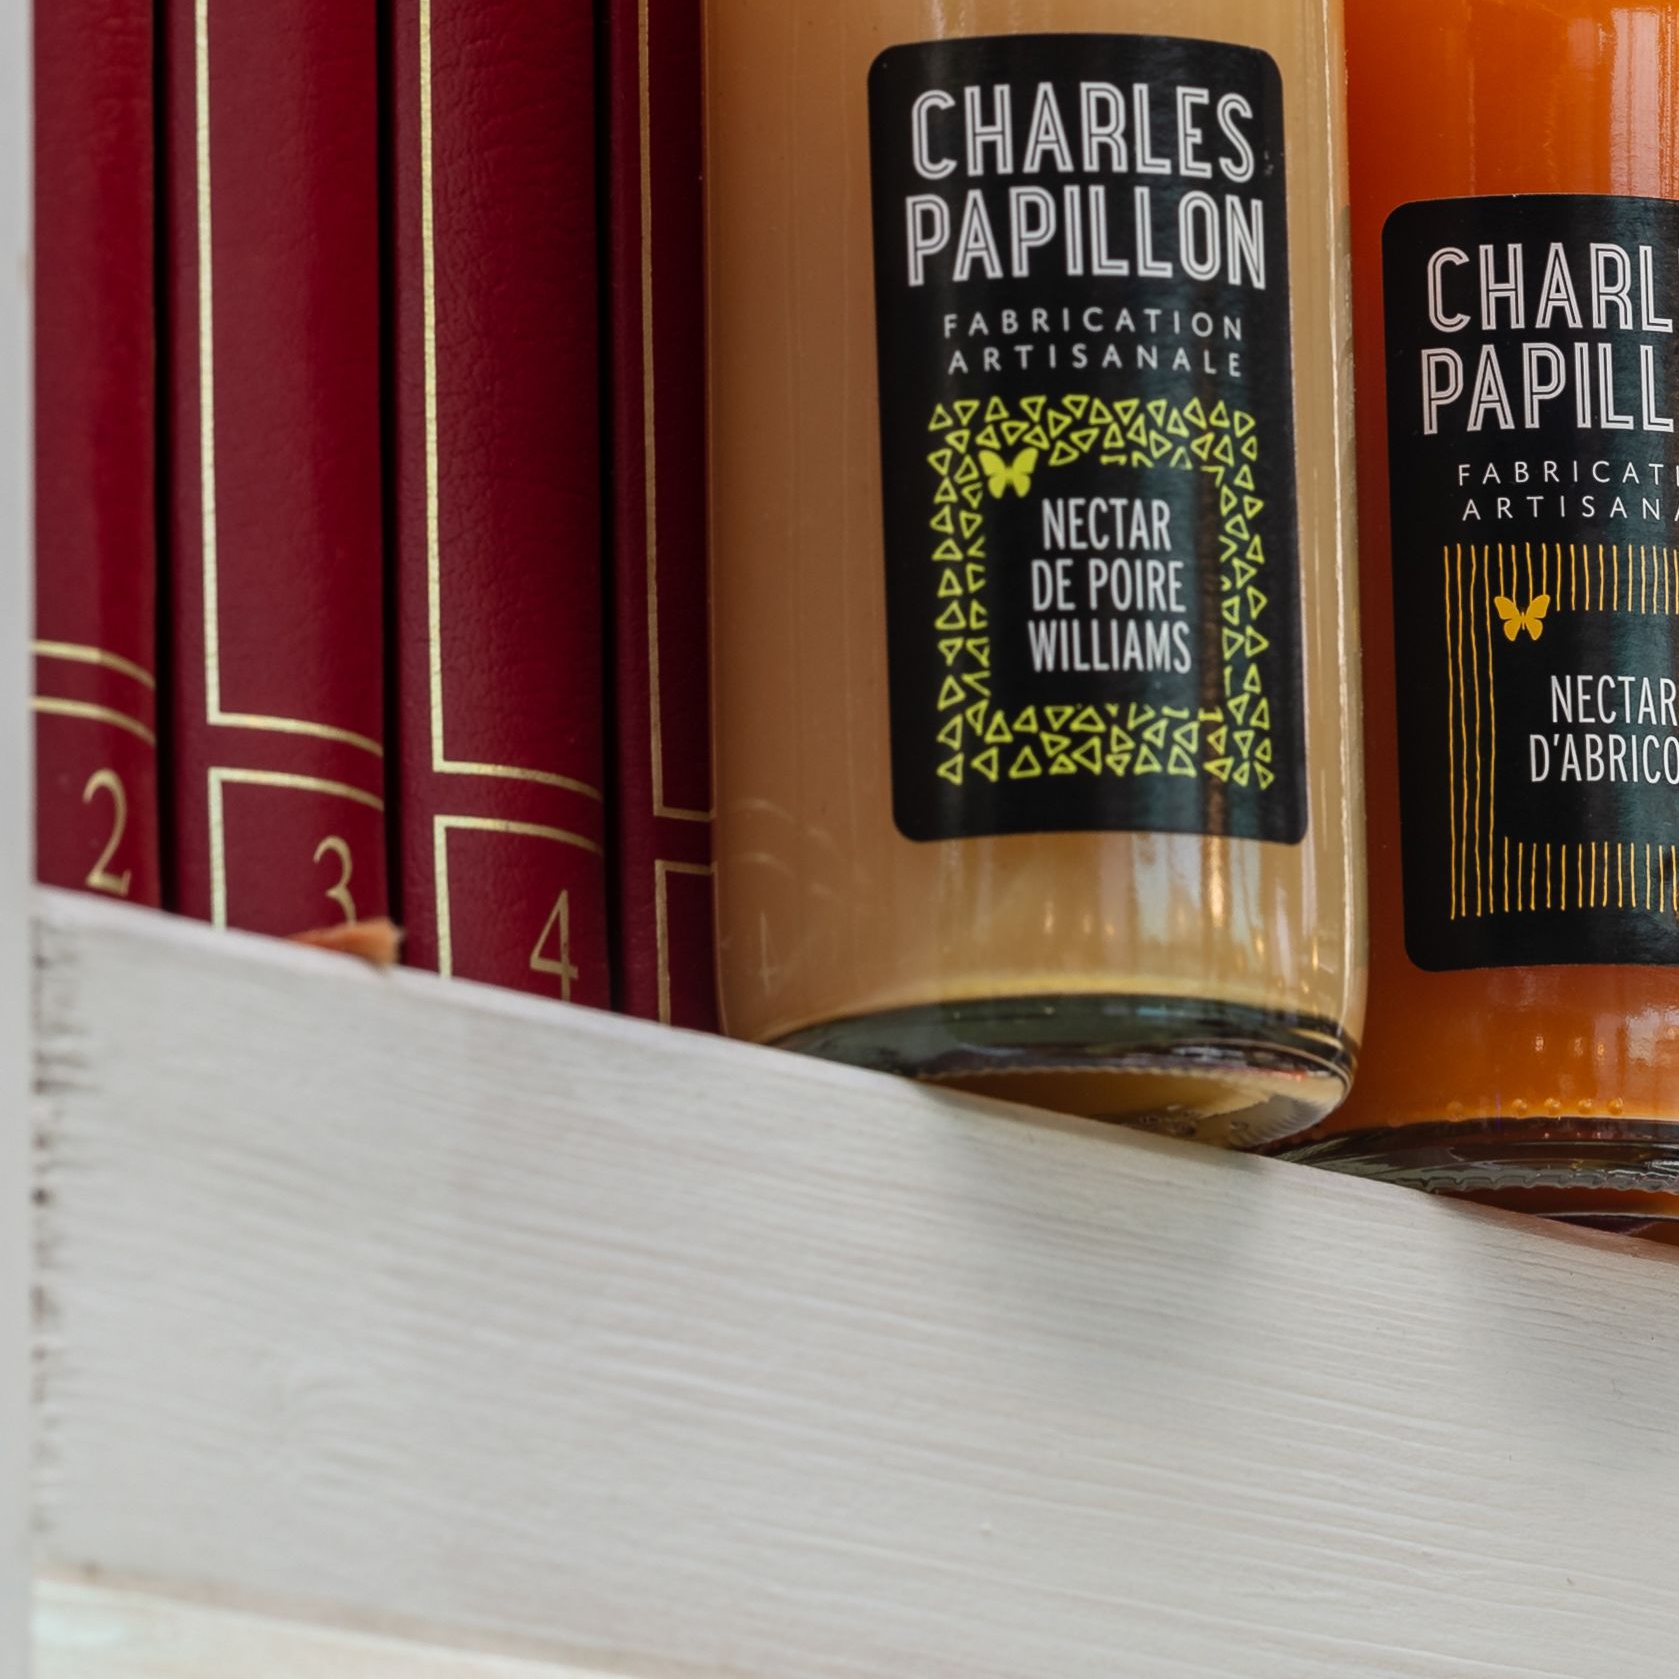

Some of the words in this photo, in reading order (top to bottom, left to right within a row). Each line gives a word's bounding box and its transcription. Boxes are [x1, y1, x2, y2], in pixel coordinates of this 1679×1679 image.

[911, 82, 1255, 183] CHARLES
[906, 185, 1266, 290] PAPILLON
[943, 307, 1242, 341] FABRICATION
[948, 344, 1242, 377] ARTISANALE
[1041, 497, 1172, 551] NECTAR
[1031, 559, 1076, 612] DE
[1088, 559, 1187, 612] POIRE
[1028, 619, 1192, 674] WILLIAMS
[1550, 675, 1678, 727] NECTAR
[83, 768, 132, 896] 2
[529, 889, 579, 1002] 4
